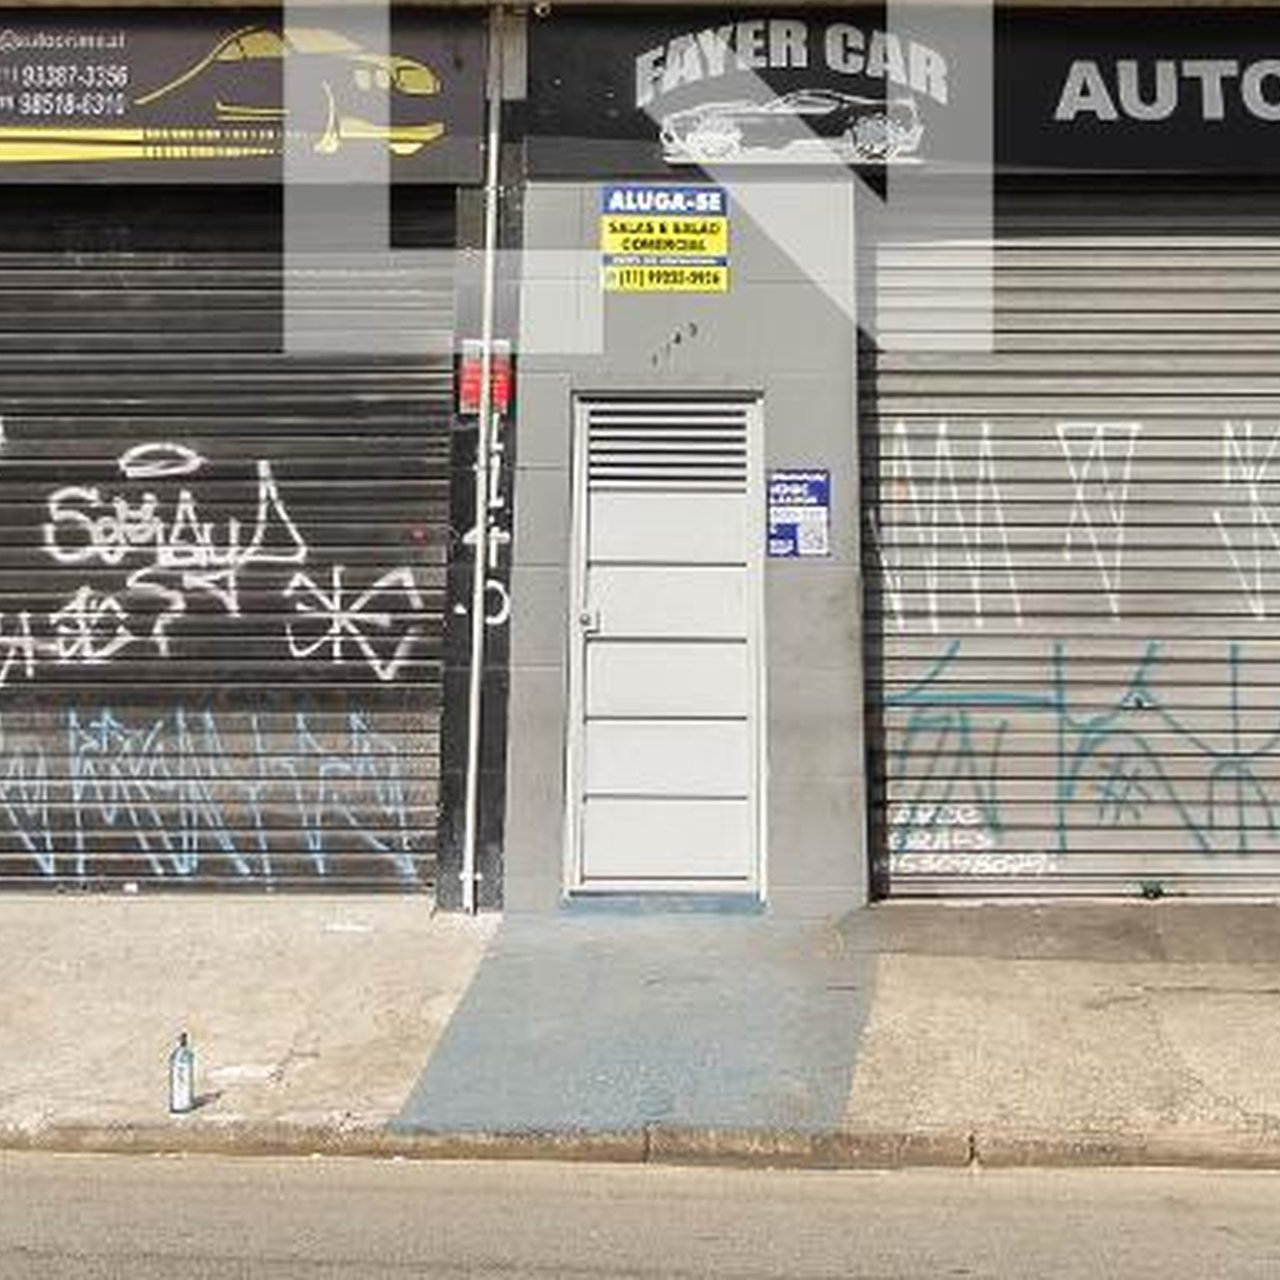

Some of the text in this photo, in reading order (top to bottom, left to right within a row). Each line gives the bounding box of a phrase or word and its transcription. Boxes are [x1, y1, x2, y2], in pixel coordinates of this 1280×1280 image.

[824, 21, 949, 106] CAR
[609, 190, 721, 211] ALUGA-SE
[621, 237, 707, 251] COMERCIAL
